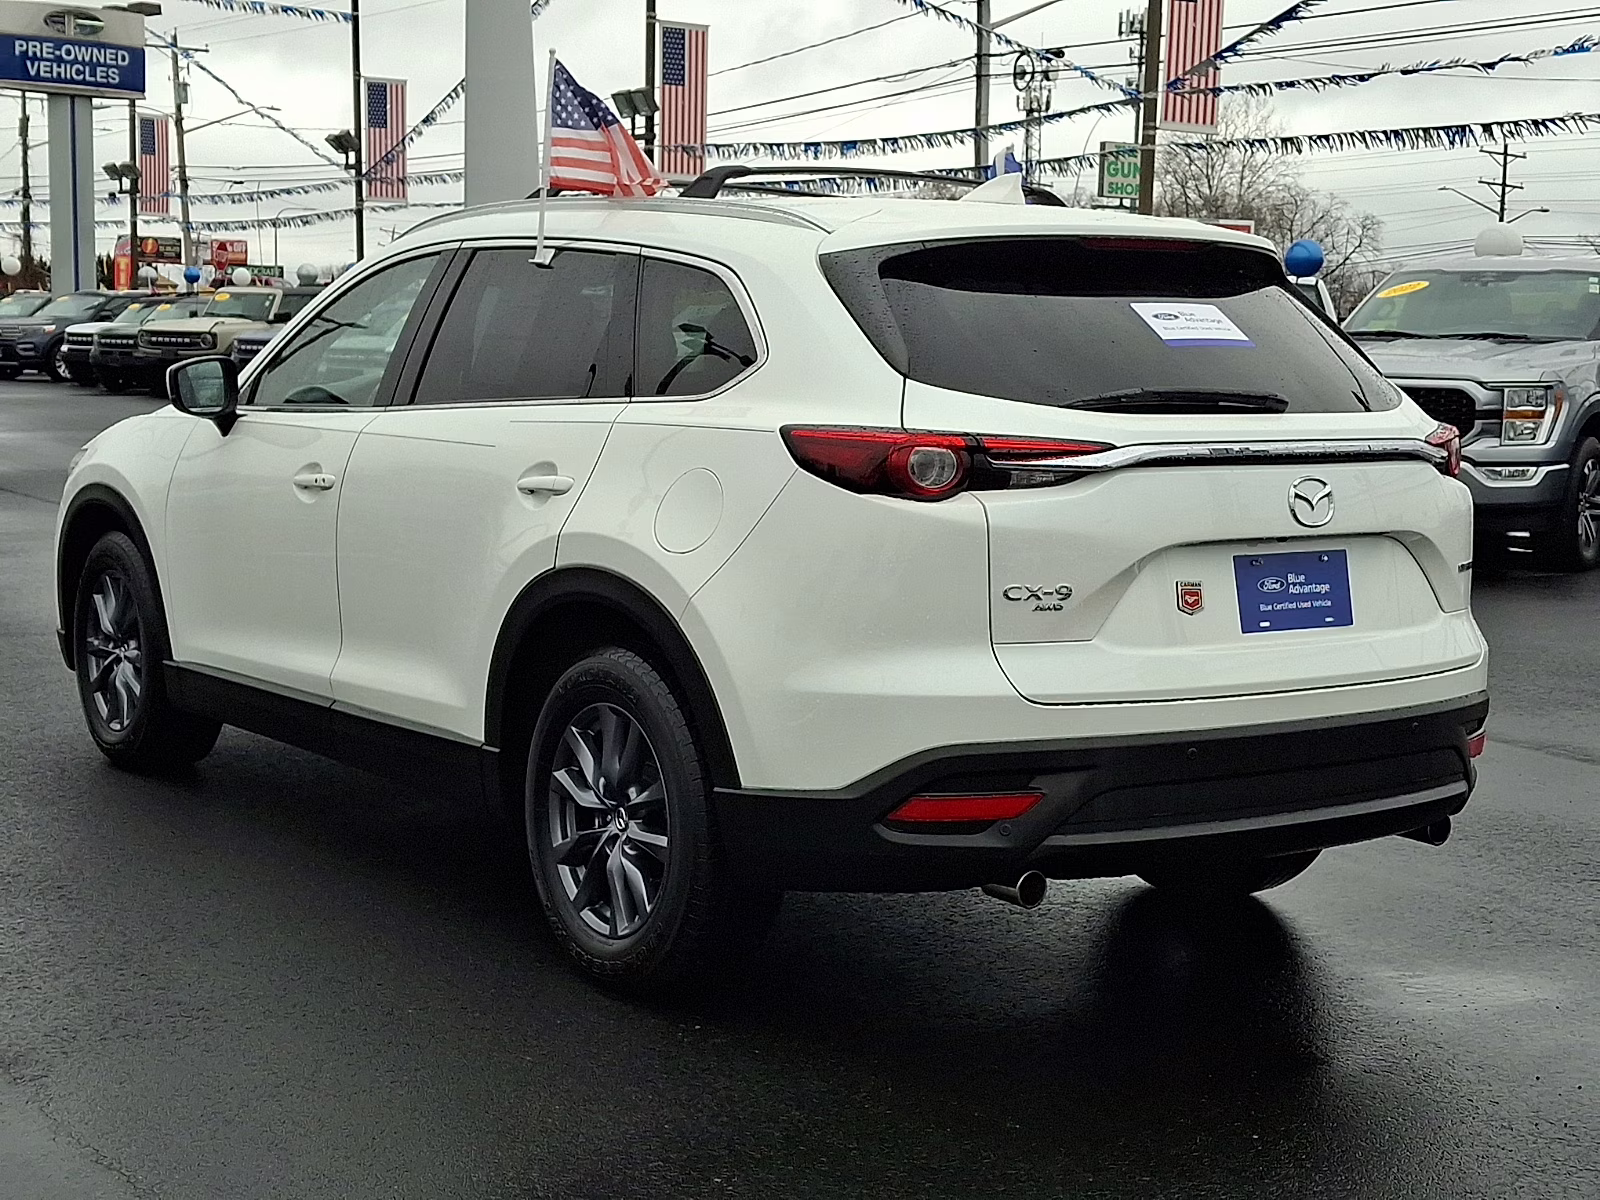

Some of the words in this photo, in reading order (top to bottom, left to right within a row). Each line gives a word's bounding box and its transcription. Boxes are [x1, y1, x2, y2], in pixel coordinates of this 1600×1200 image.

[14, 40, 130, 66] PRE-OWNED
[26, 60, 120, 84] VEHICLES
[1287, 573, 1306, 584] Blue
[1002, 583, 1073, 602] CX-9
[1288, 583, 1331, 595] Advantage
[1031, 601, 1065, 613] AWD
[1259, 603, 1273, 612] Blue
[1273, 600, 1297, 611] Certified
[1297, 600, 1312, 609] Used
[1312, 599, 1332, 608] Vehicle
